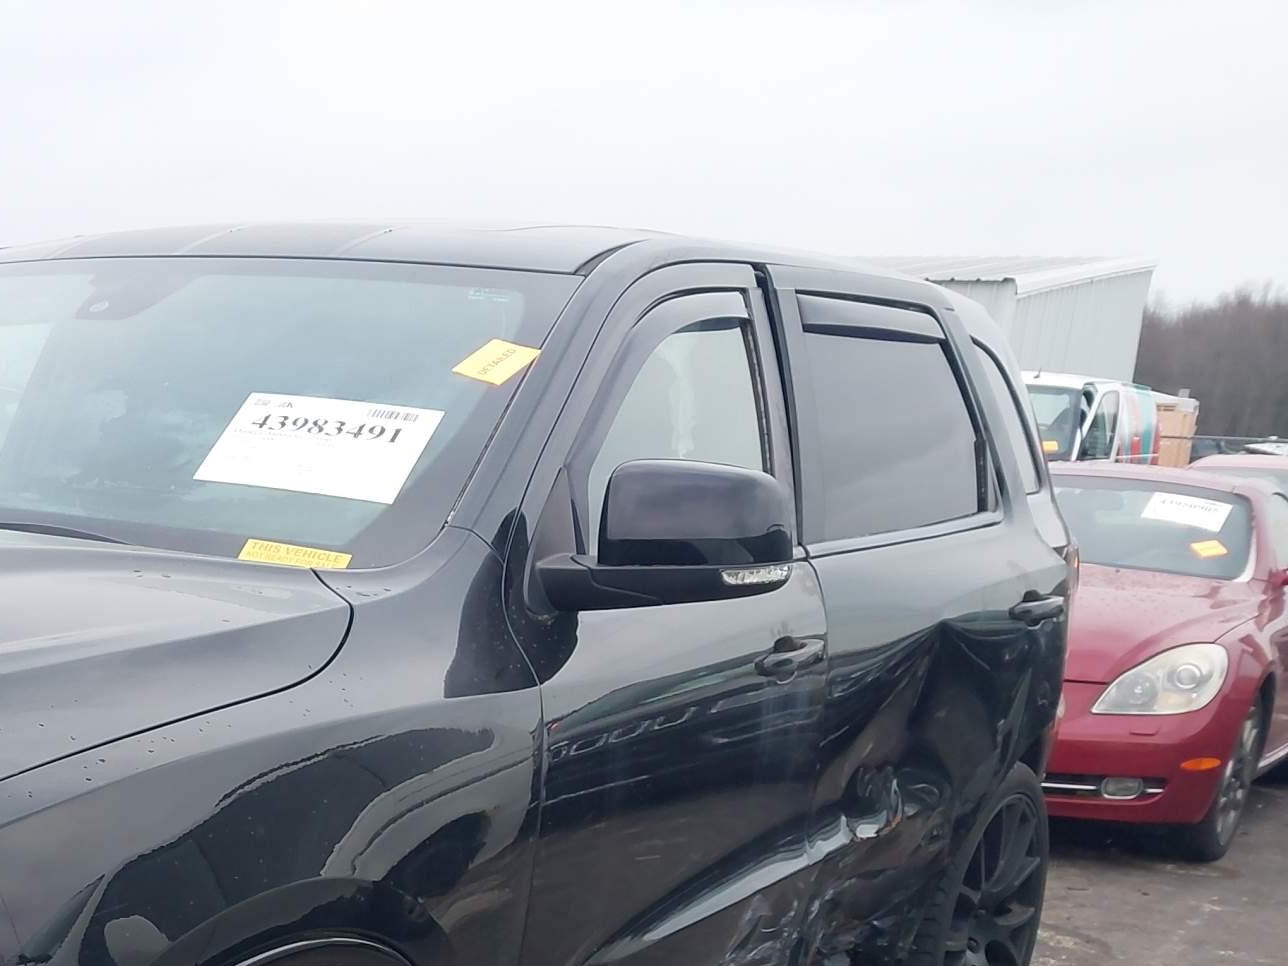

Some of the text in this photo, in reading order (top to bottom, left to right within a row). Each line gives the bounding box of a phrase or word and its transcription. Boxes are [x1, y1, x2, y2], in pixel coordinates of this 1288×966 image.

[251, 413, 402, 443] 43983491
[251, 542, 345, 563] THIS VEHICLE
